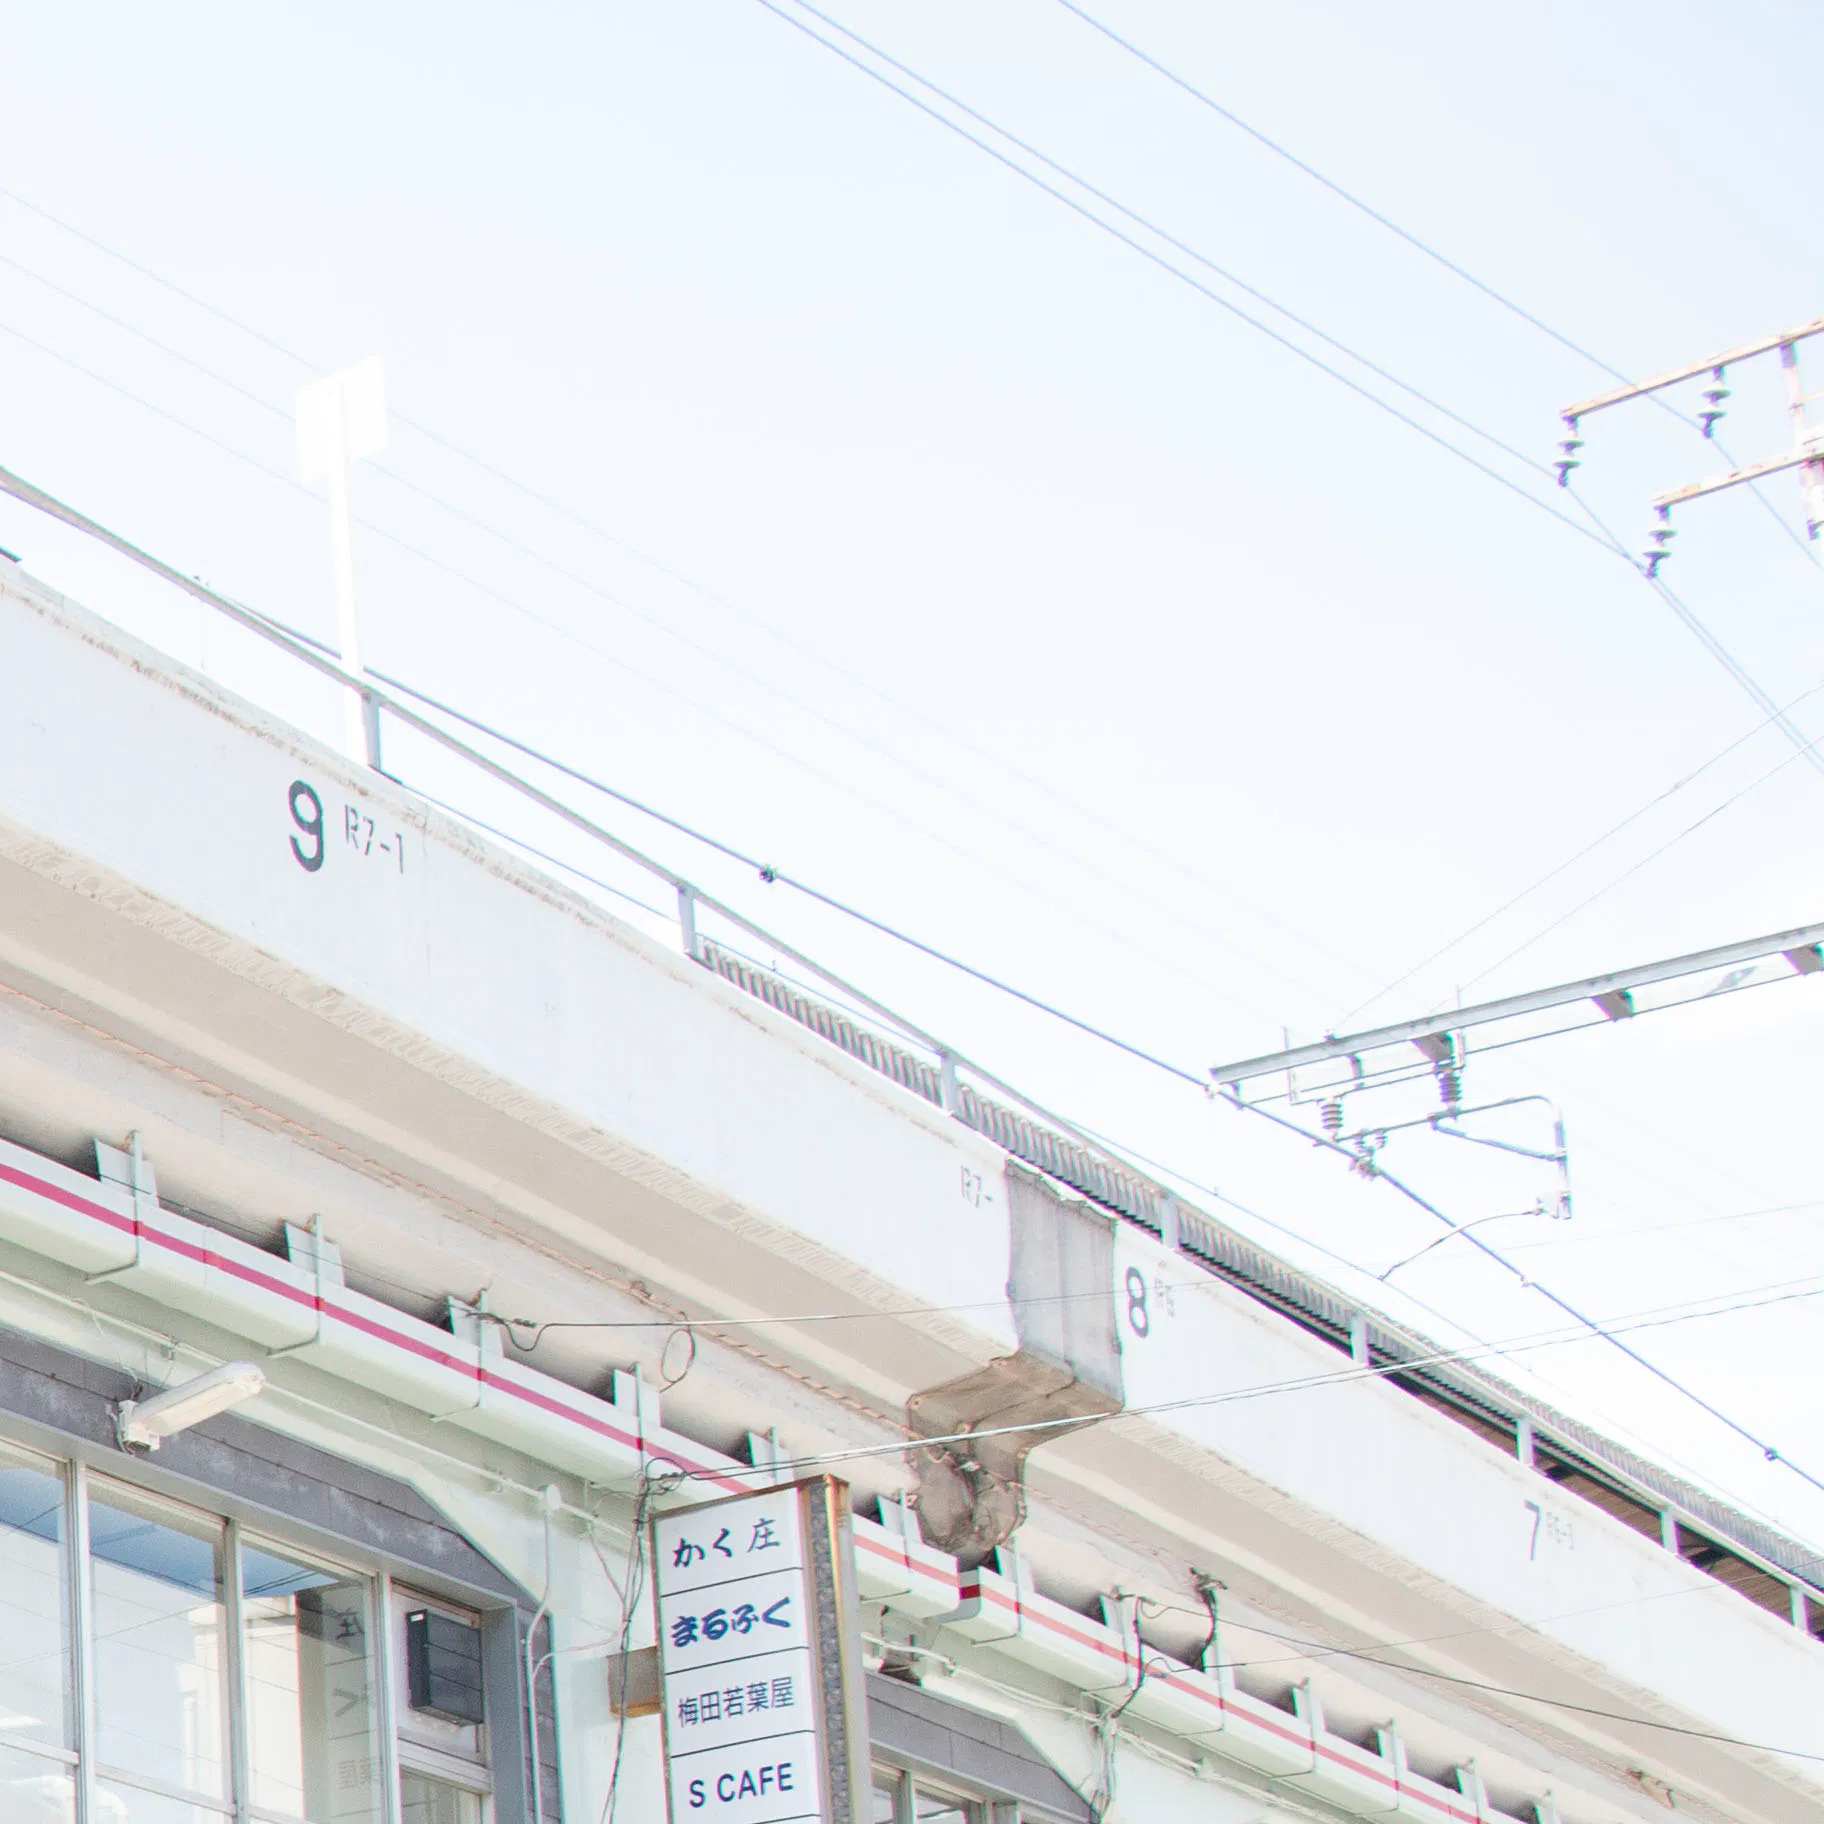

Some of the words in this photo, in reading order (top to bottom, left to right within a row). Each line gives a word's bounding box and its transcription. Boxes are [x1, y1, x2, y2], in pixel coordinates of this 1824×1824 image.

[288, 779, 325, 873] 9
[344, 803, 405, 875] R7-1
[1125, 1265, 1149, 1339] 8
[673, 1517, 782, 1568] かく庄
[1524, 1498, 1540, 1561] 7
[670, 1596, 791, 1648] まるふく
[677, 1675, 796, 1729] 梅田若葉屋
[688, 1779, 706, 1809] S
[716, 1761, 794, 1803] CAFE
